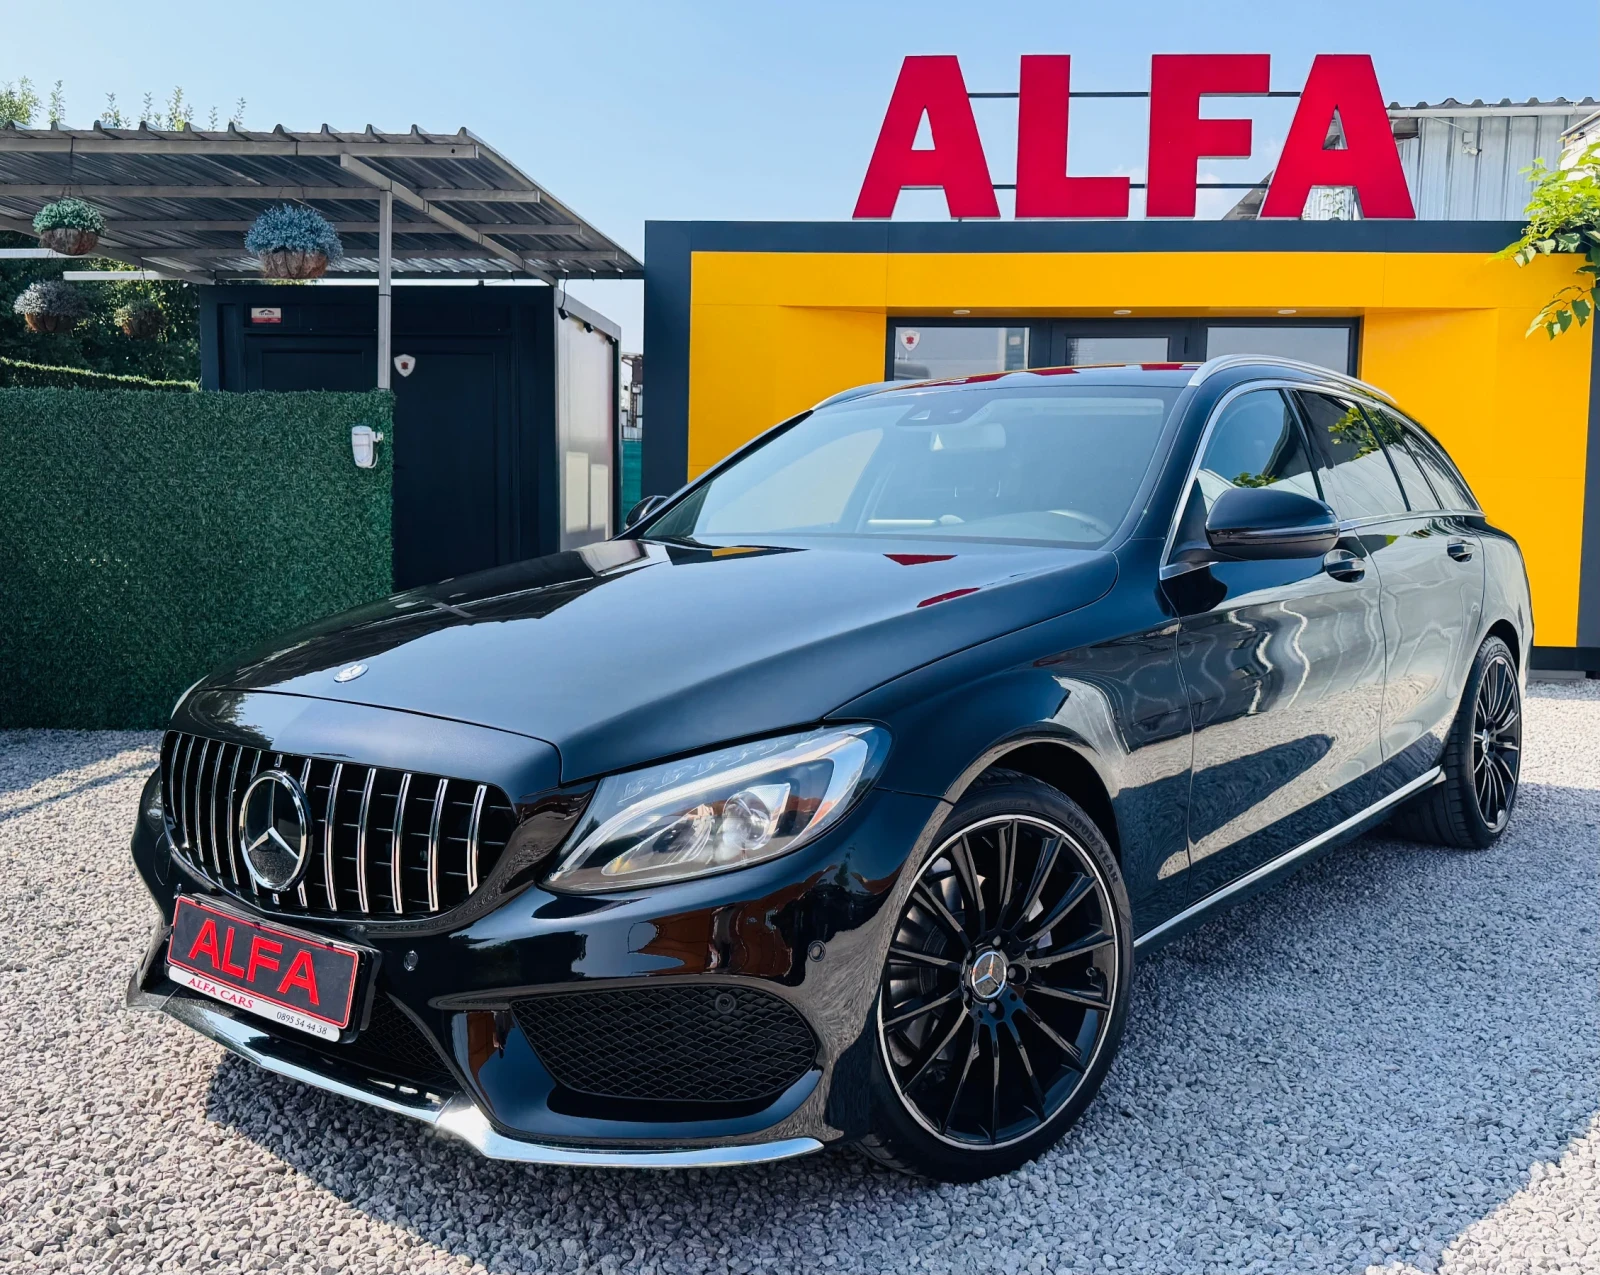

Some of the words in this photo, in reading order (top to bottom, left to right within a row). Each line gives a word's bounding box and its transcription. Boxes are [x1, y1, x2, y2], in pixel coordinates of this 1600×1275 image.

[853, 54, 1416, 219] ALFA
[188, 918, 320, 1006] ALFA
[188, 977, 217, 996] ALFA
[220, 990, 254, 1009] CARS
[276, 1011, 294, 1024] 0895
[295, 1017, 305, 1027] 54
[306, 1023, 316, 1032] 44
[316, 1025, 328, 1035] 38
